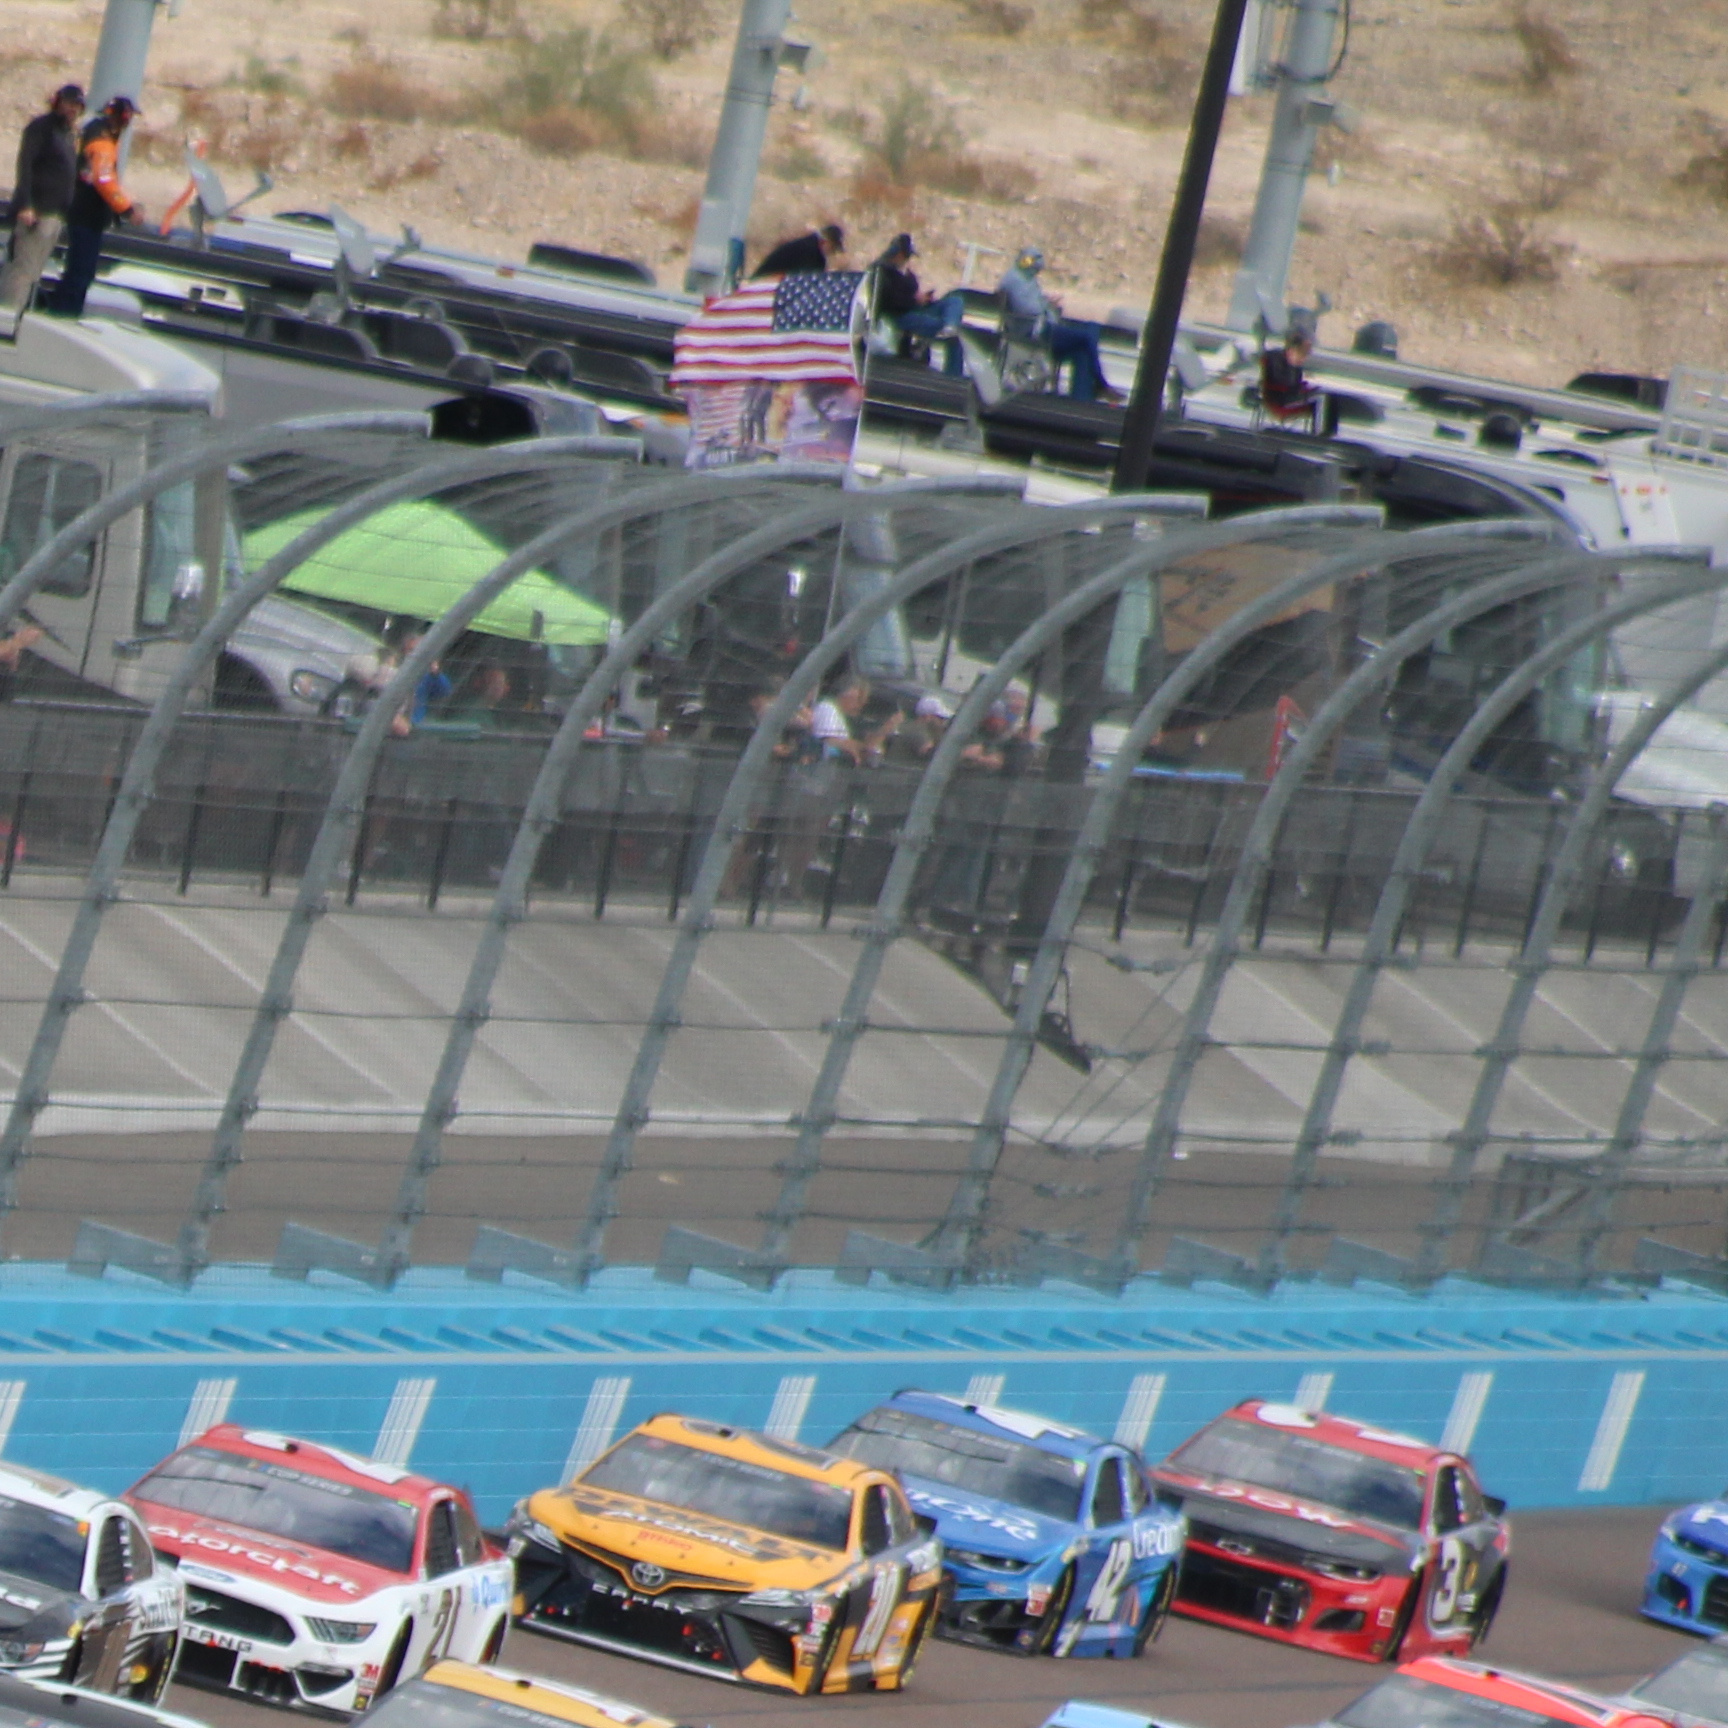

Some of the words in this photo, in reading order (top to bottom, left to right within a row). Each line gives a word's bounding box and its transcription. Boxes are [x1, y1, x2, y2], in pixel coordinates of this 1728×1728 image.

[146, 1525, 362, 1594] otorcraft
[1431, 1539, 1464, 1623] 3
[183, 1626, 253, 1653] TANG
